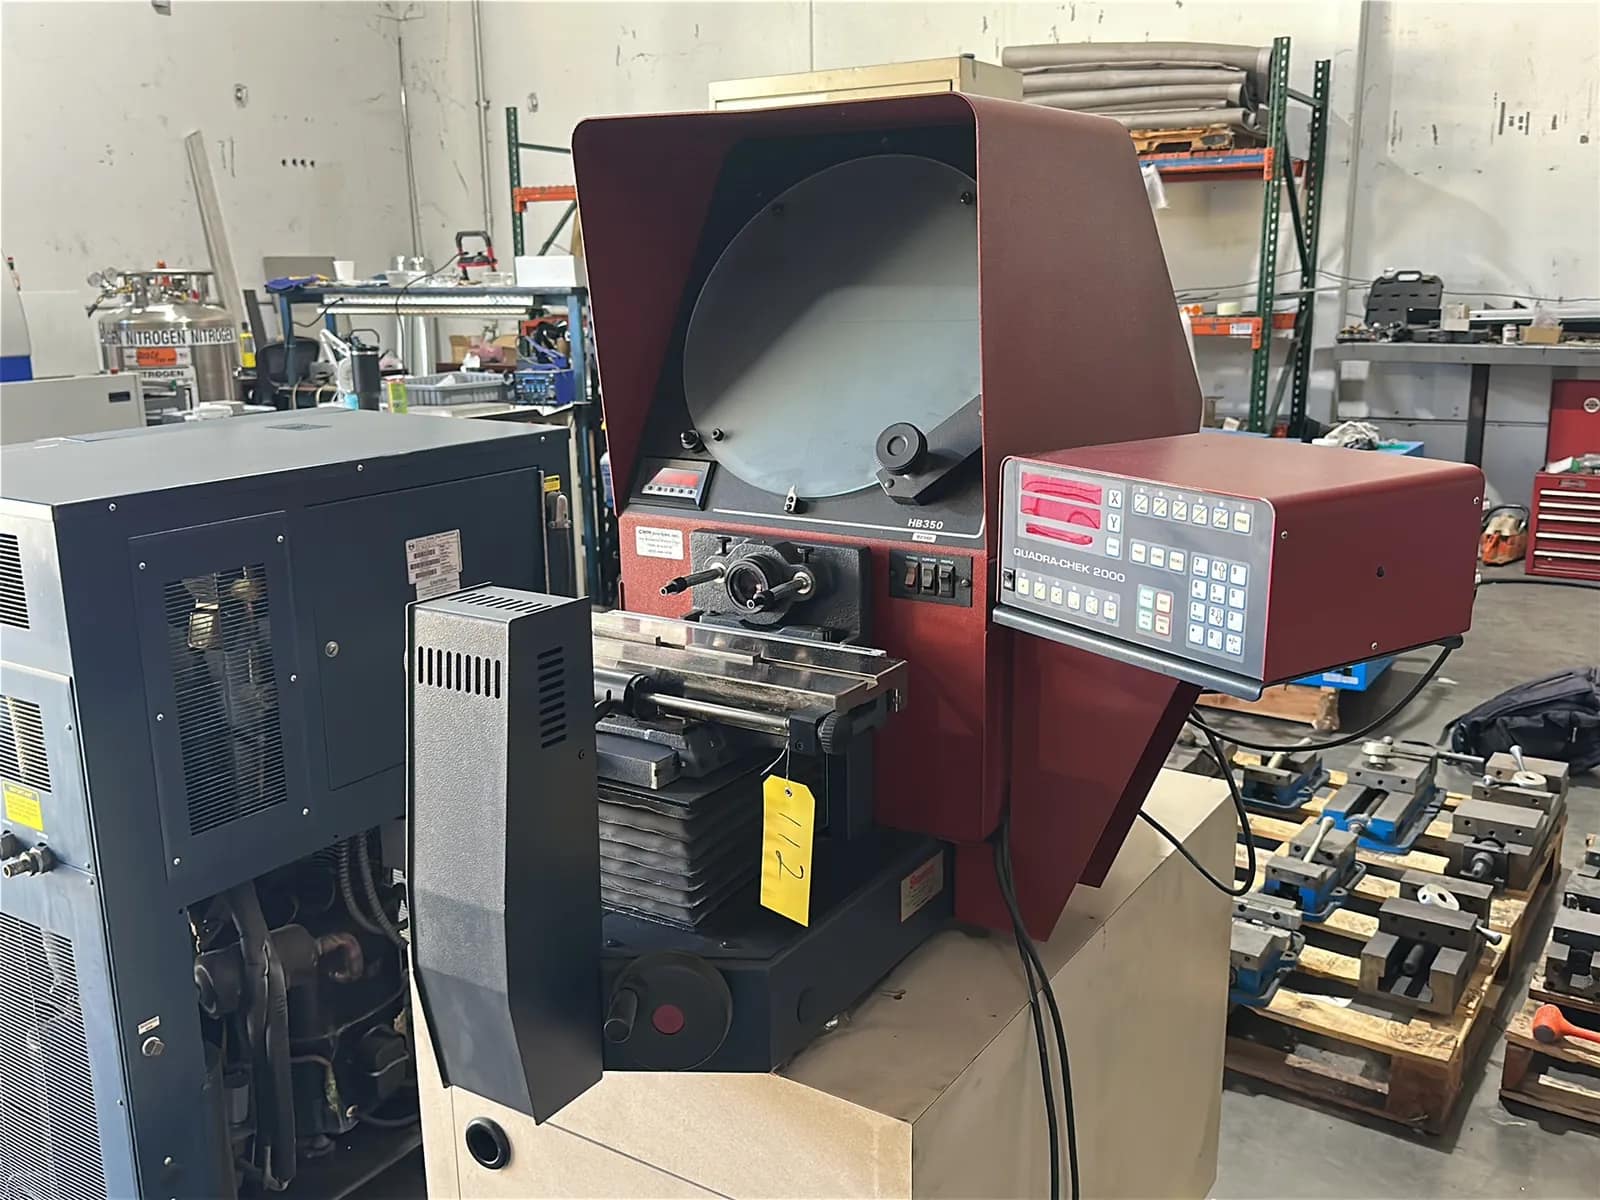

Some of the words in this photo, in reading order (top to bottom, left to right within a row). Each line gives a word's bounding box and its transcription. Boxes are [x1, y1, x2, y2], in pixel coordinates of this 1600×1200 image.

[126, 329, 186, 345] NITROGEN
[142, 370, 184, 378] TROGEN
[1111, 492, 1119, 505] X
[908, 518, 943, 529] HB350
[1110, 515, 1118, 529] Y
[1013, 547, 1091, 575] QUADRA-CHEK
[1093, 567, 1126, 583] 2000
[775, 812, 805, 880] 112
